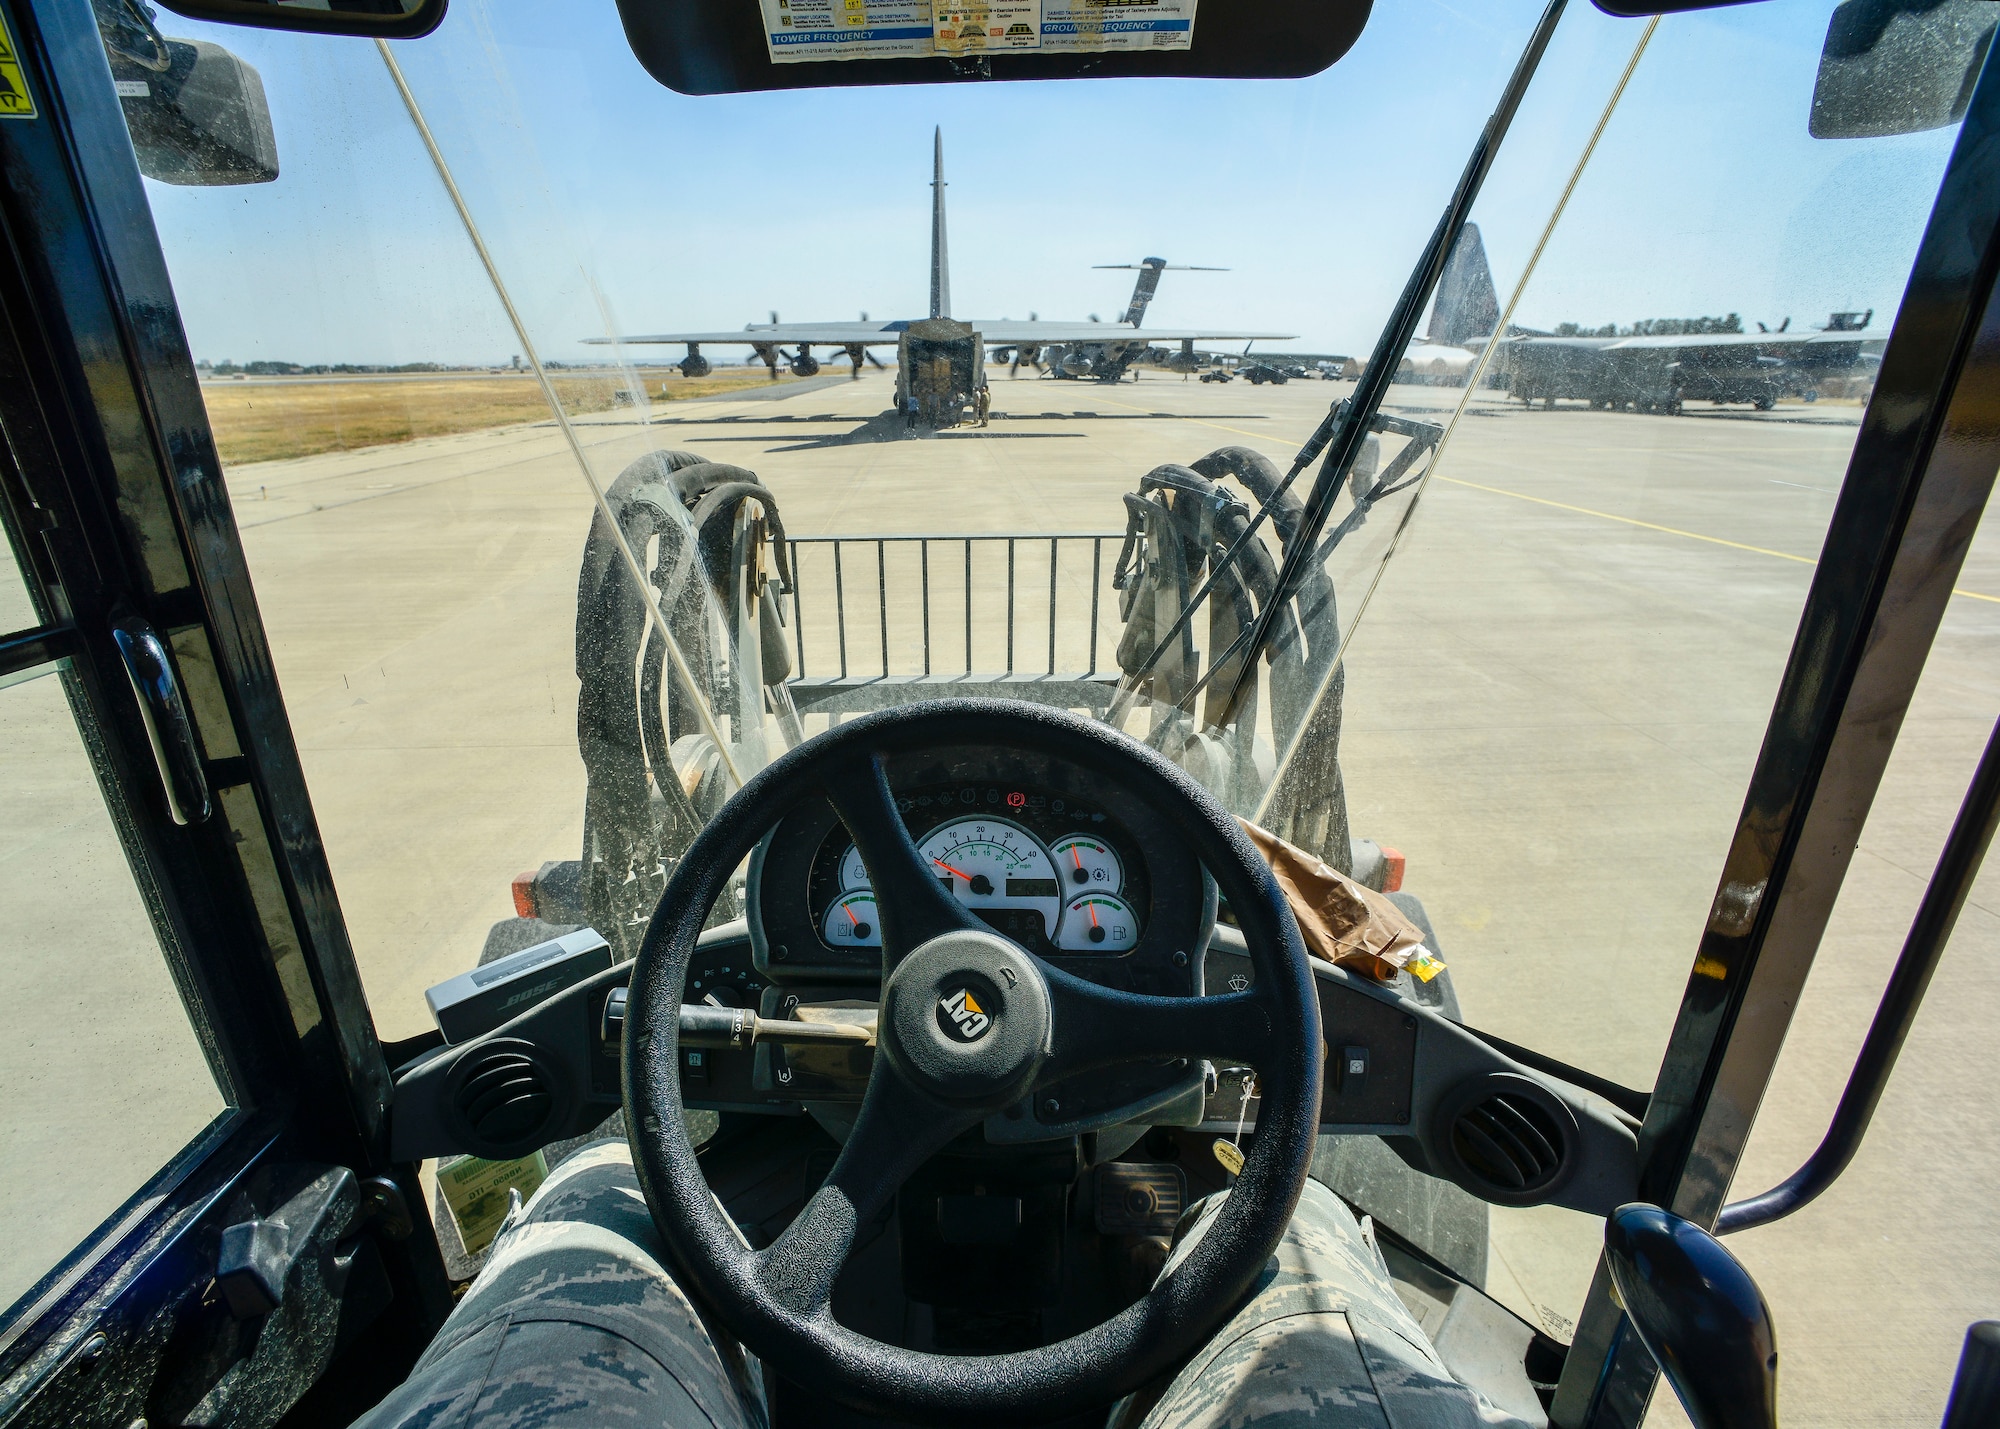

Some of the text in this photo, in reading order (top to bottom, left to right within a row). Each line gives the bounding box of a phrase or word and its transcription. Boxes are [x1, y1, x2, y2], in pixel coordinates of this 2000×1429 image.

[1044, 22, 1155, 32] GROUND FREQUENCY
[775, 32, 874, 43] TOWER FREQUENCY
[502, 978, 561, 1009] BOSE
[940, 988, 989, 1038] CAT
[735, 1024, 742, 1032] 3
